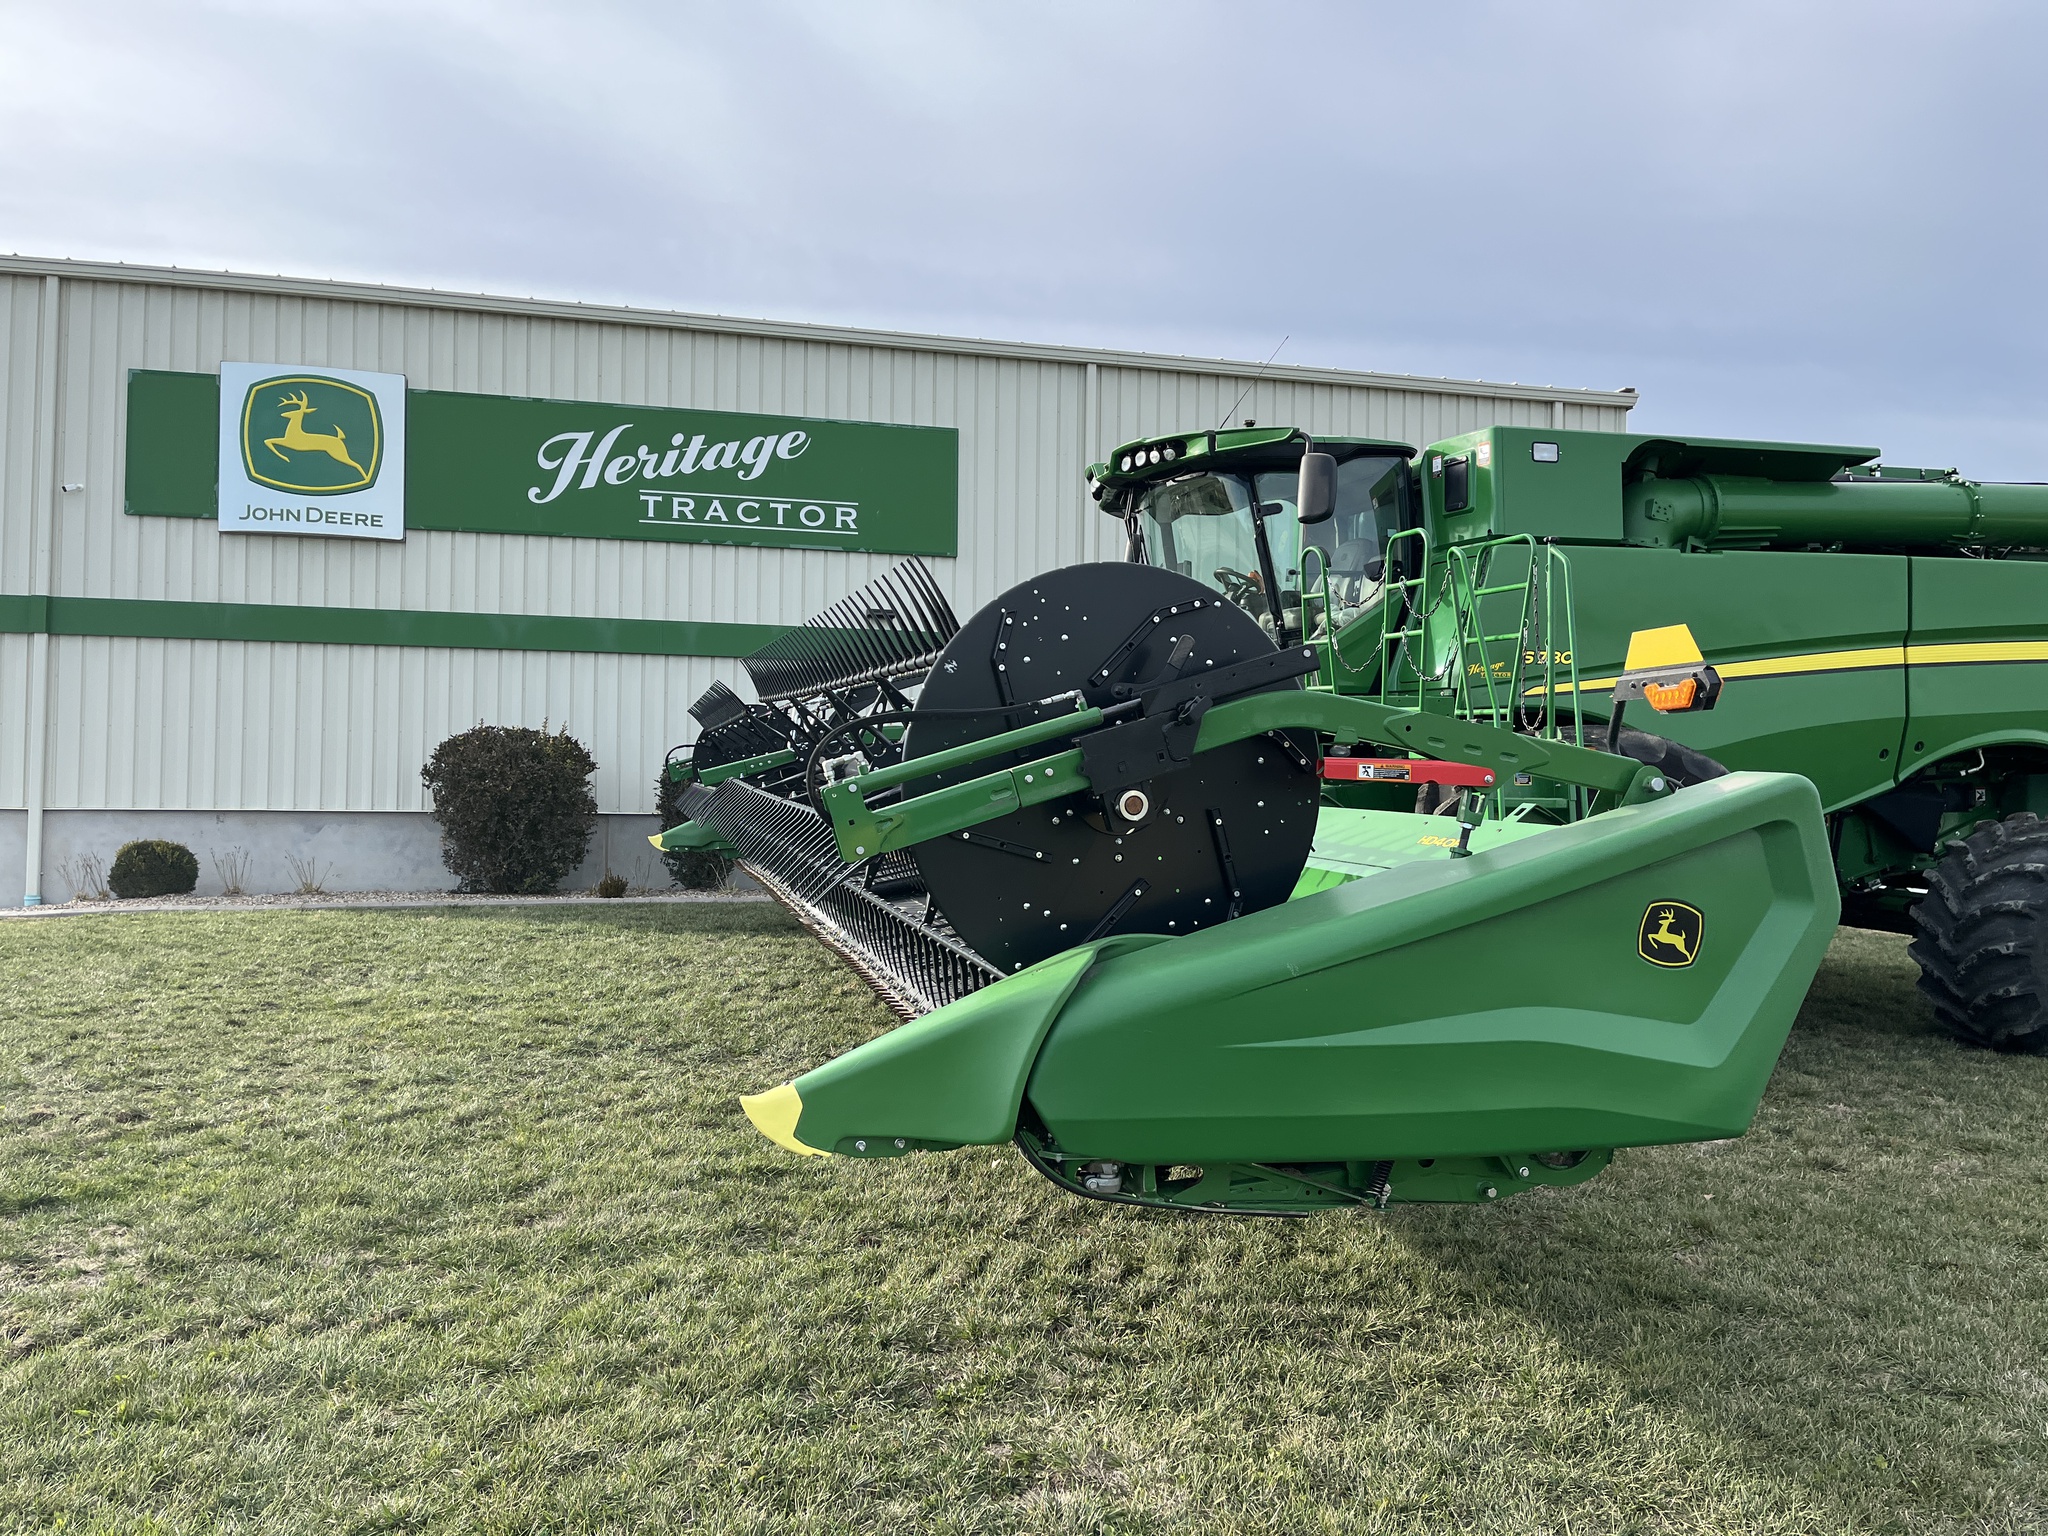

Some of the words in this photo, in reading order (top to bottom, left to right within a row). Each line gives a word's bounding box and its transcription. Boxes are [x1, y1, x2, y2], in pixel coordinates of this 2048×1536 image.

[527, 423, 812, 504] Heritage
[238, 504, 301, 522] JOHN
[306, 507, 384, 528] DEERE
[639, 495, 858, 529] TRACTOR
[1467, 661, 1505, 677] Herage
